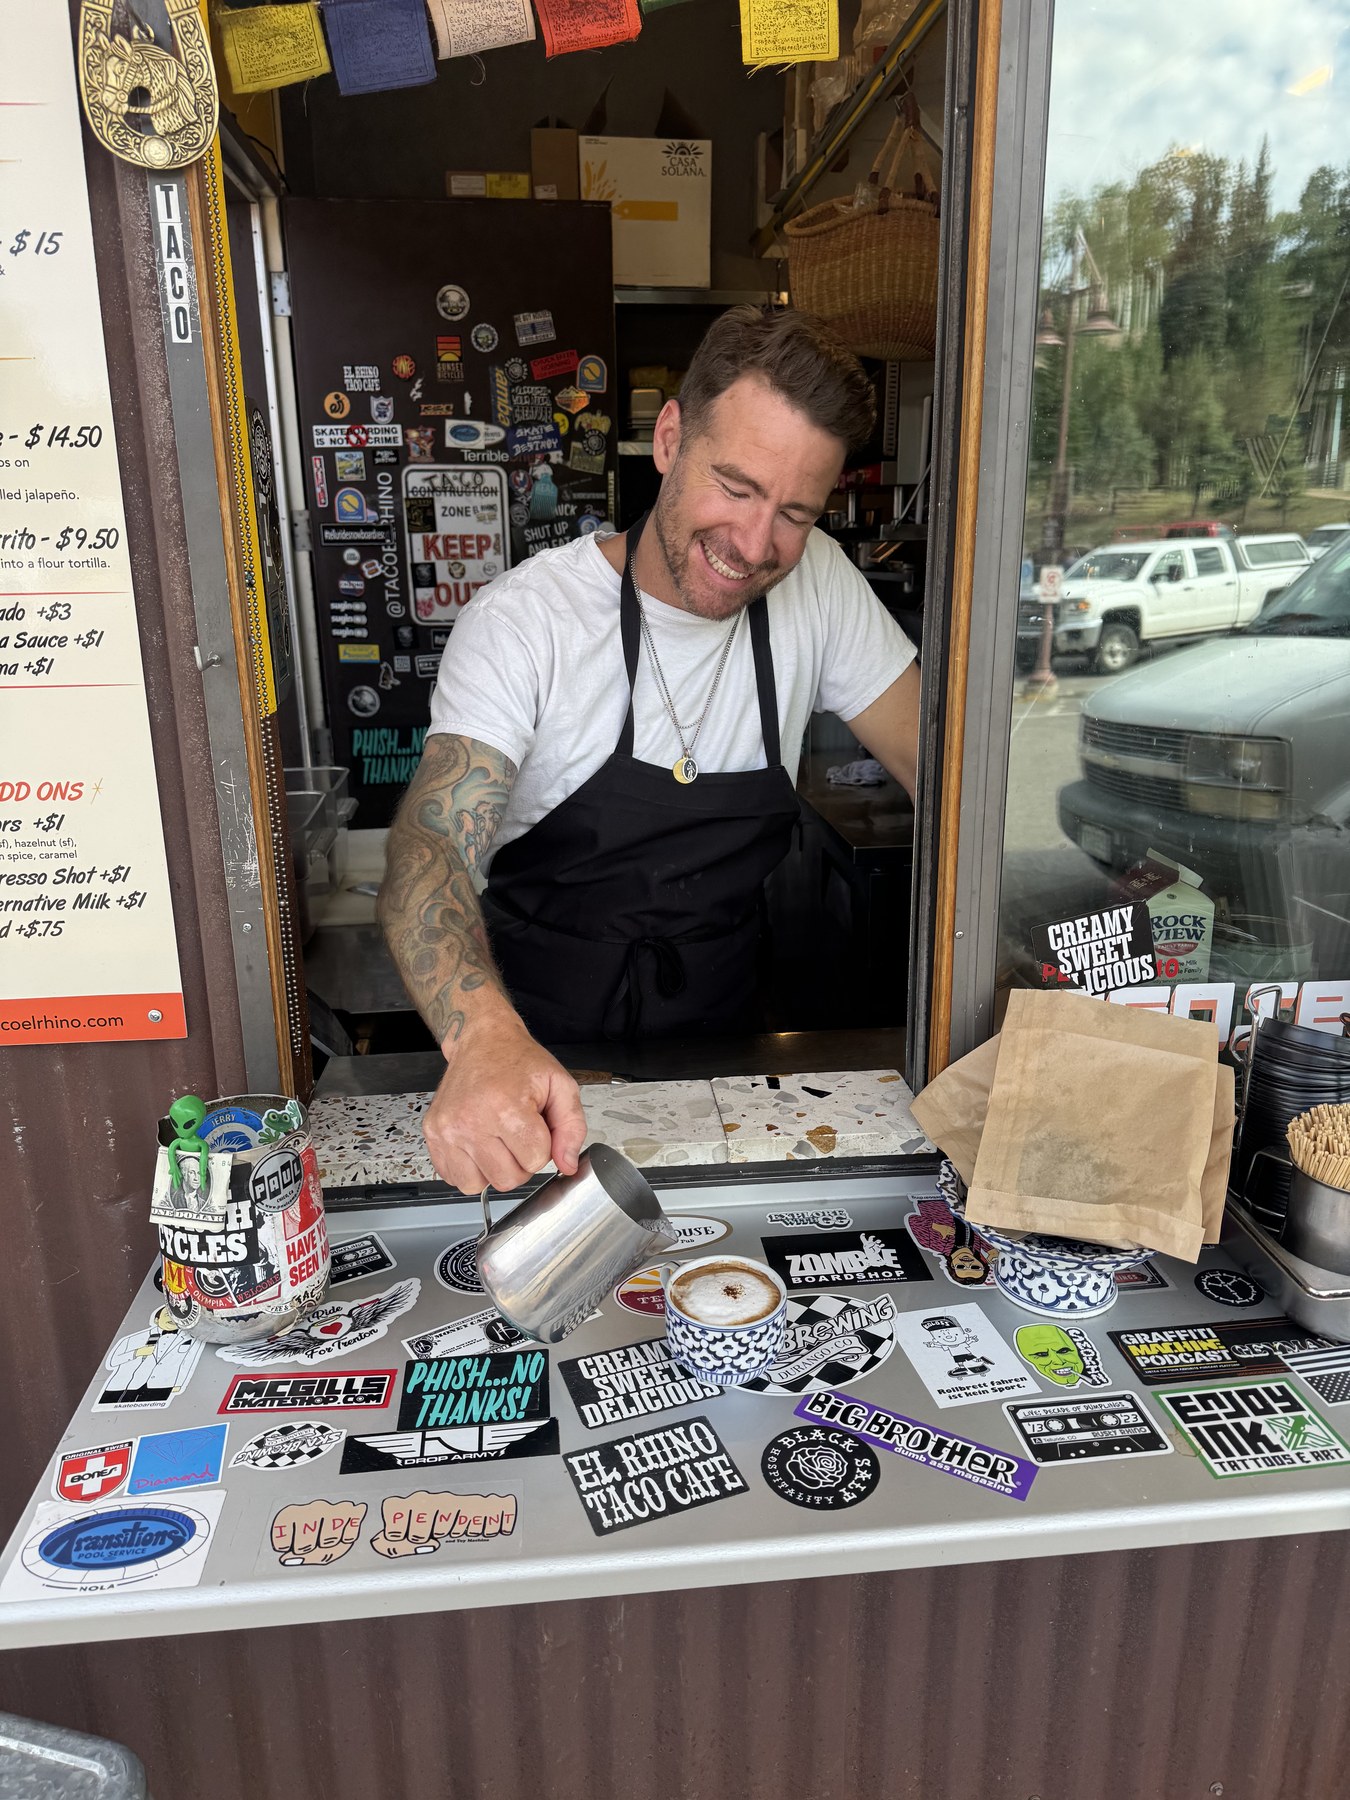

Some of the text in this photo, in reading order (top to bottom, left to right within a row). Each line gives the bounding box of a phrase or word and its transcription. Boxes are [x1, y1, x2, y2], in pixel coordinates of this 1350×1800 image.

[661, 166, 704, 177] SOLANA
[669, 157, 697, 167] CASA
[158, 185, 190, 341] TACO
[355, 365, 379, 378] RHINO
[344, 378, 381, 391] TACO CAFE
[314, 427, 398, 436] SKATEBOARDING
[515, 424, 554, 437] SKATE
[316, 437, 326, 445] IS
[329, 437, 350, 445] NOT
[366, 436, 399, 445] CRIME
[14, 459, 30, 468] on
[460, 449, 510, 463] Terrible
[25, 489, 80, 503] jalapeño.
[411, 486, 498, 497] CONSTRUCTION
[441, 506, 471, 517] ZONE
[56, 526, 120, 551] $9.50
[524, 521, 569, 541] SHUT UP
[422, 533, 491, 561] KEEP
[1, 558, 24, 568] into
[38, 557, 65, 569] flour
[68, 557, 110, 569] tortilla.
[37, 601, 72, 622] +$3
[14, 629, 104, 649] Sauce +$1
[24, 656, 54, 676] +$1
[37, 781, 84, 801] ONS
[33, 812, 65, 833] +$1
[14, 838, 77, 849] hazelnut (sf),
[8, 850, 78, 862] spice, caramel
[52, 866, 97, 885] Shot
[99, 865, 131, 885] +$1
[72, 892, 110, 910] Milk
[116, 890, 147, 911] +$1
[15, 919, 66, 939] +$.75
[1047, 905, 1135, 951] CREAMY
[1151, 914, 1207, 930] ROCK
[1055, 933, 1133, 975] SWEET
[211, 1113, 236, 1128] JERRY
[253, 1158, 302, 1202] PAUL
[151, 1207, 226, 1224] ONE DOLLAR
[768, 1209, 848, 1223] EXPLORE
[783, 1216, 851, 1229] WITH GG
[160, 1227, 248, 1263] CYCLES
[286, 1227, 317, 1265] HAVE
[289, 1253, 319, 1287] SEEN
[792, 1270, 905, 1284] BOARDSHOP
[236, 1273, 281, 1302] WELCOME
[314, 1304, 343, 1321] Ride
[434, 1322, 470, 1340] MONEY
[1120, 1327, 1217, 1346] GRAFFITI
[304, 1328, 379, 1359] For Trenton
[1127, 1339, 1226, 1357] MACHINE
[778, 1337, 853, 1381] DURANGO CO
[1067, 1328, 1110, 1385] SMOKIN
[1135, 1350, 1233, 1368] PODCAST
[234, 1376, 389, 1398] MCGILLS
[594, 1361, 684, 1400] SWEET
[937, 1376, 1028, 1396] Rollbrett fahren
[230, 1394, 385, 1409] SKATESHOP.COM
[949, 1384, 1026, 1401] ist kein Sport.
[113, 1401, 167, 1410] skateboarding
[415, 1386, 532, 1428] THANKS!
[580, 1378, 721, 1428] DELICIOUS
[1043, 1407, 1071, 1415] DECADE
[1084, 1401, 1126, 1411] DUMPLINGS
[305, 1431, 342, 1448] SKA
[1119, 1426, 1148, 1435] RHINO
[64, 1442, 130, 1461] ORIGINAL SWISS
[404, 1450, 498, 1465] DROP ARMY
[568, 1422, 719, 1491] EL RHINO
[1215, 1451, 1295, 1474] TATTOOS
[1313, 1447, 1347, 1462] ART
[70, 1465, 118, 1483] BONES
[777, 1428, 872, 1503] BLACK SALT
[894, 1445, 1014, 1495] dumb ass magazine
[135, 1464, 215, 1490] Diamond
[767, 1447, 835, 1505] HOSPITALITY
[583, 1453, 744, 1528] TACO CAFE
[48, 1521, 188, 1566] Transitions
[77, 1547, 148, 1560] POOL SERVICE
[79, 1584, 116, 1592] NOLA
